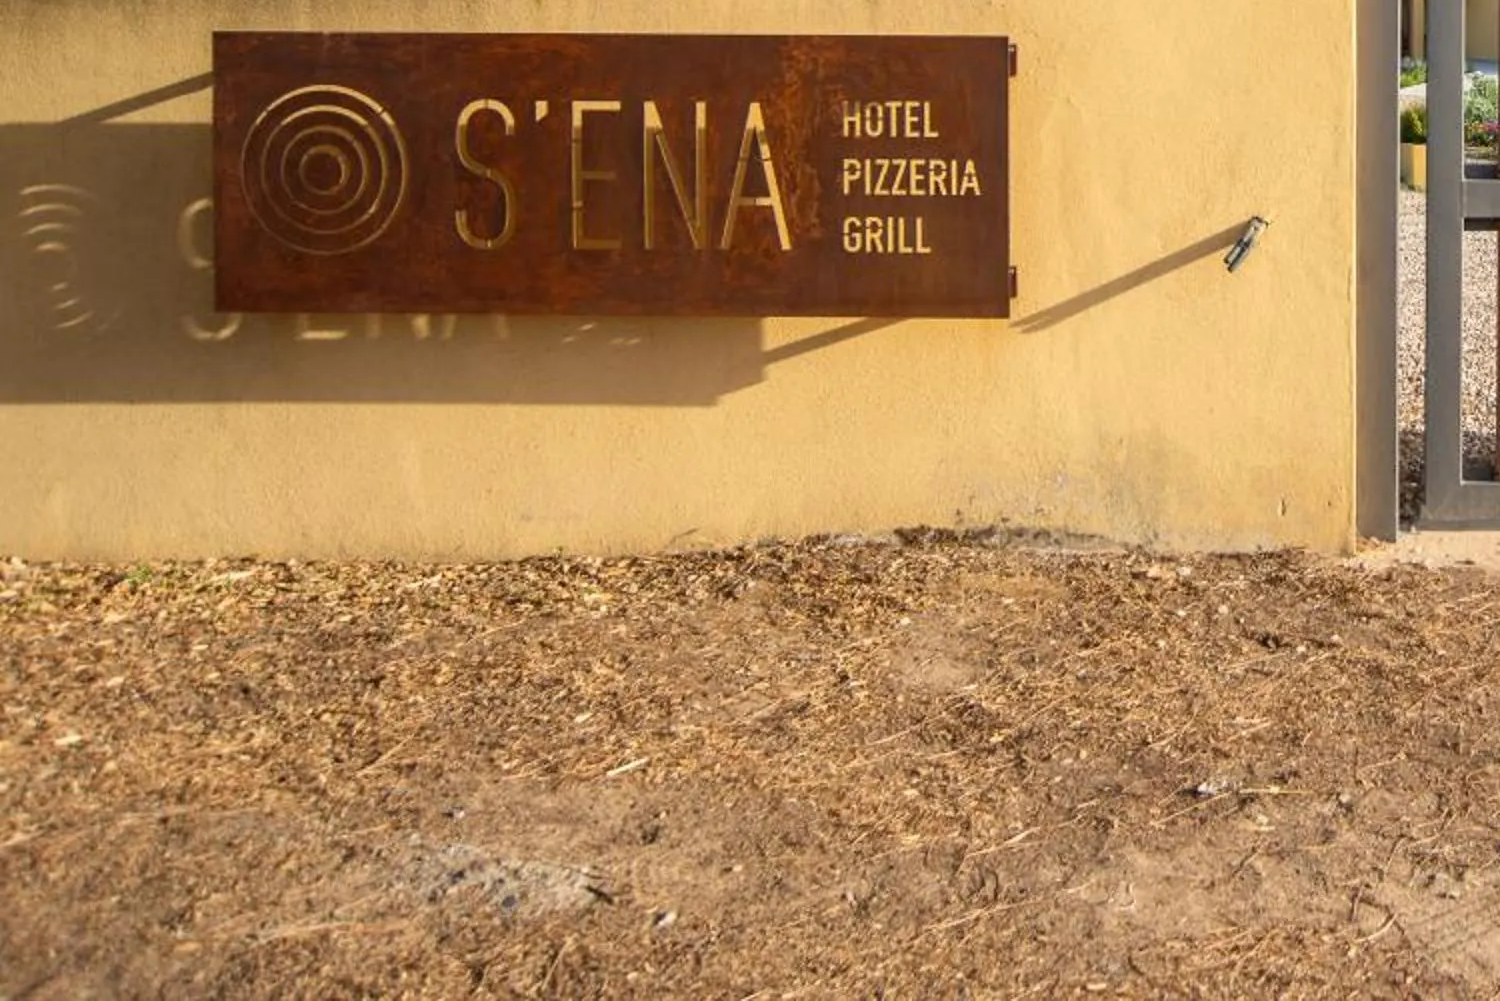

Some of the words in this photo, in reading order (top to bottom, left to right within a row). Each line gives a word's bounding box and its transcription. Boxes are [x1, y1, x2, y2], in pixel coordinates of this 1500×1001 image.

[842, 101, 939, 138] HOTEL
[455, 98, 793, 251] S'ENA
[842, 159, 982, 196] PIZZERIA
[842, 216, 932, 254] GRILL
